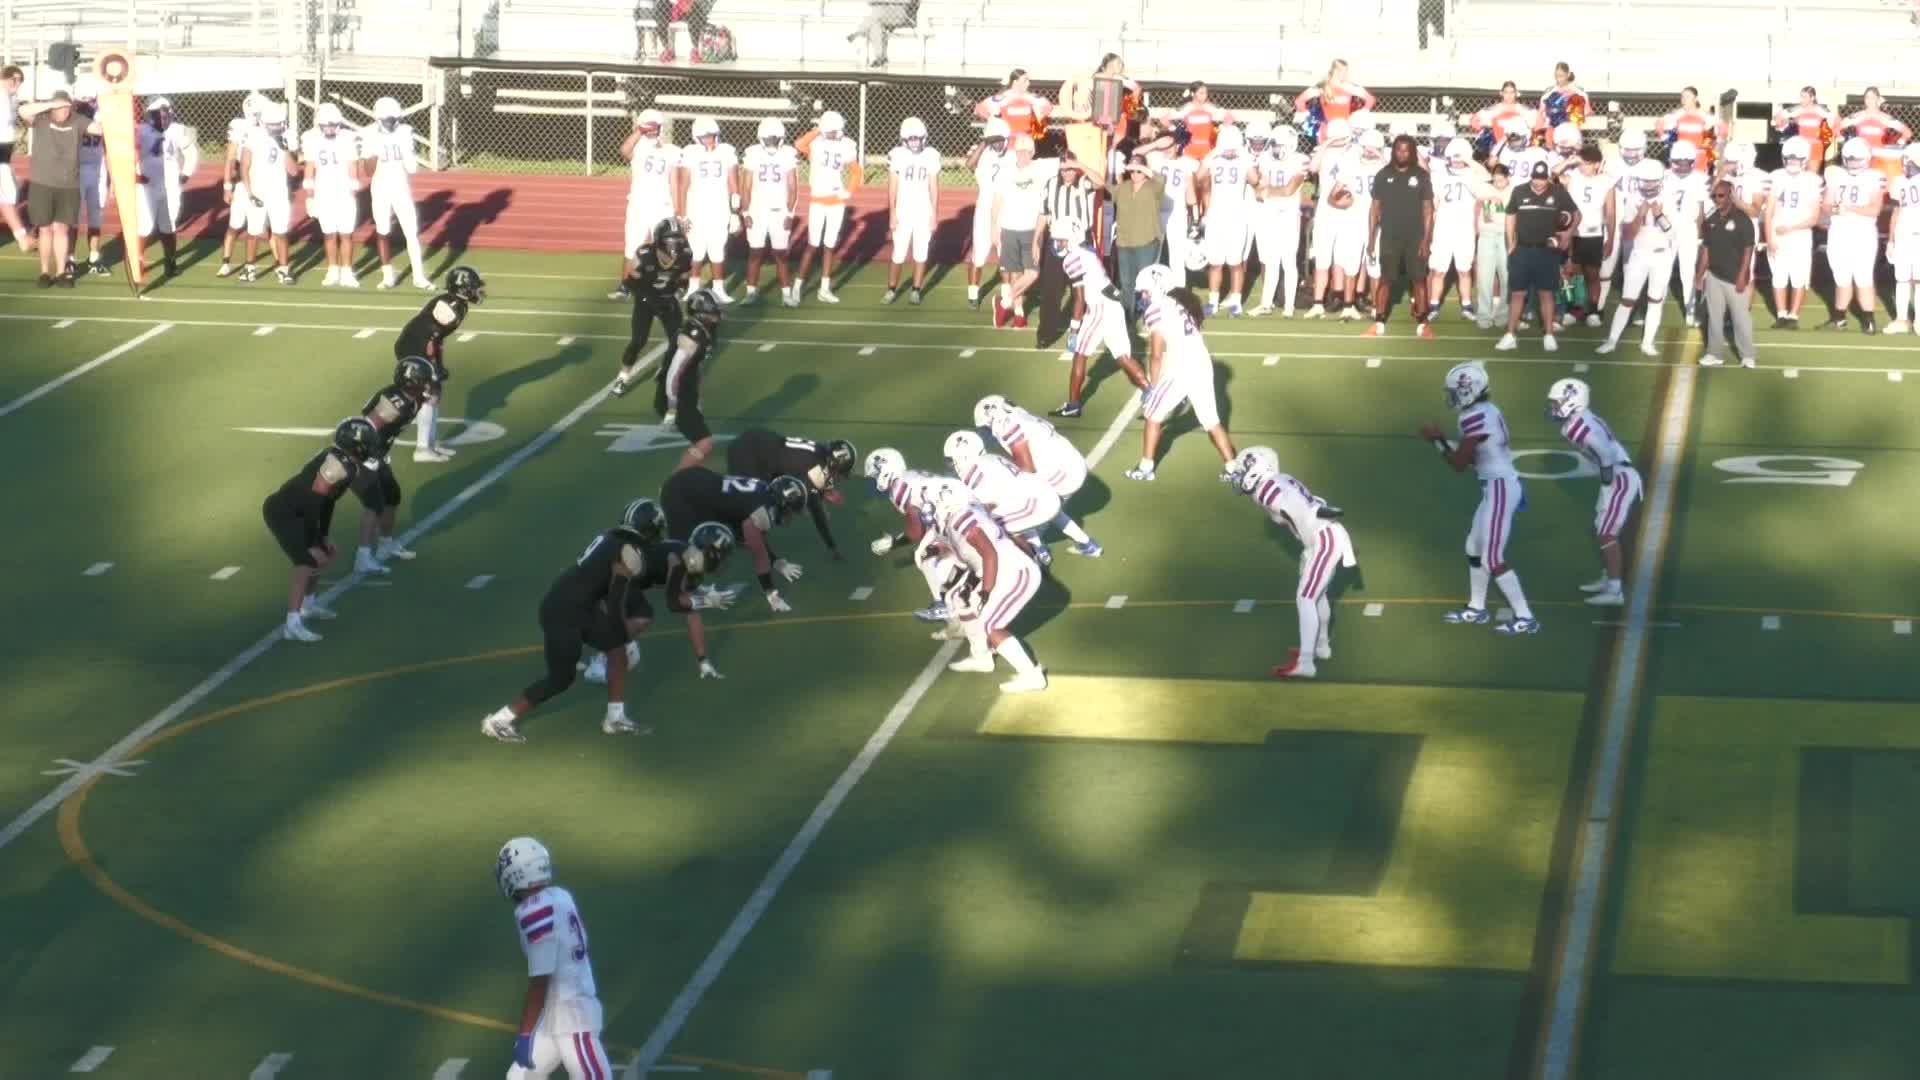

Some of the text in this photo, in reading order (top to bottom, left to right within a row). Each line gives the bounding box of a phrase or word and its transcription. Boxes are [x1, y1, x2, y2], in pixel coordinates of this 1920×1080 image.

[758, 163, 782, 183] 25
[1214, 166, 1239, 185] 29
[1582, 186, 1593, 204] 5
